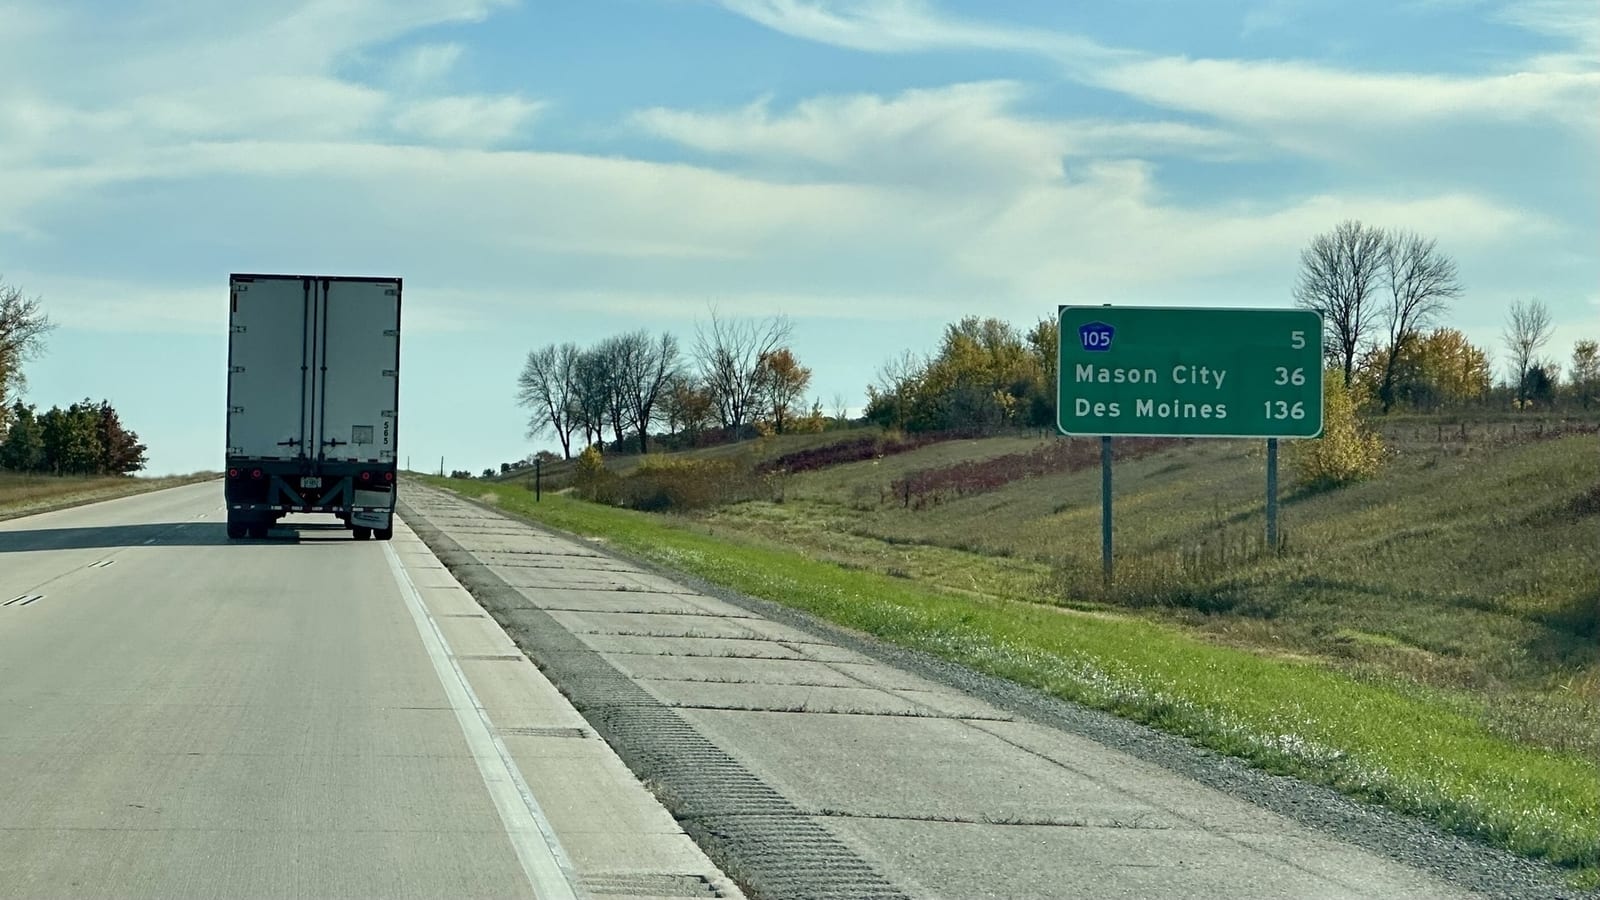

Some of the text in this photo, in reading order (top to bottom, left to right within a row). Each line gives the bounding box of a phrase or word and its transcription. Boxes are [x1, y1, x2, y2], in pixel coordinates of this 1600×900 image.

[1083, 331, 1110, 346] 105
[1291, 331, 1305, 349] 5
[1076, 364, 1227, 389] Mason City
[1274, 367, 1305, 386] 36
[1076, 399, 1227, 419] Des Moines
[1264, 401, 1305, 419] 136
